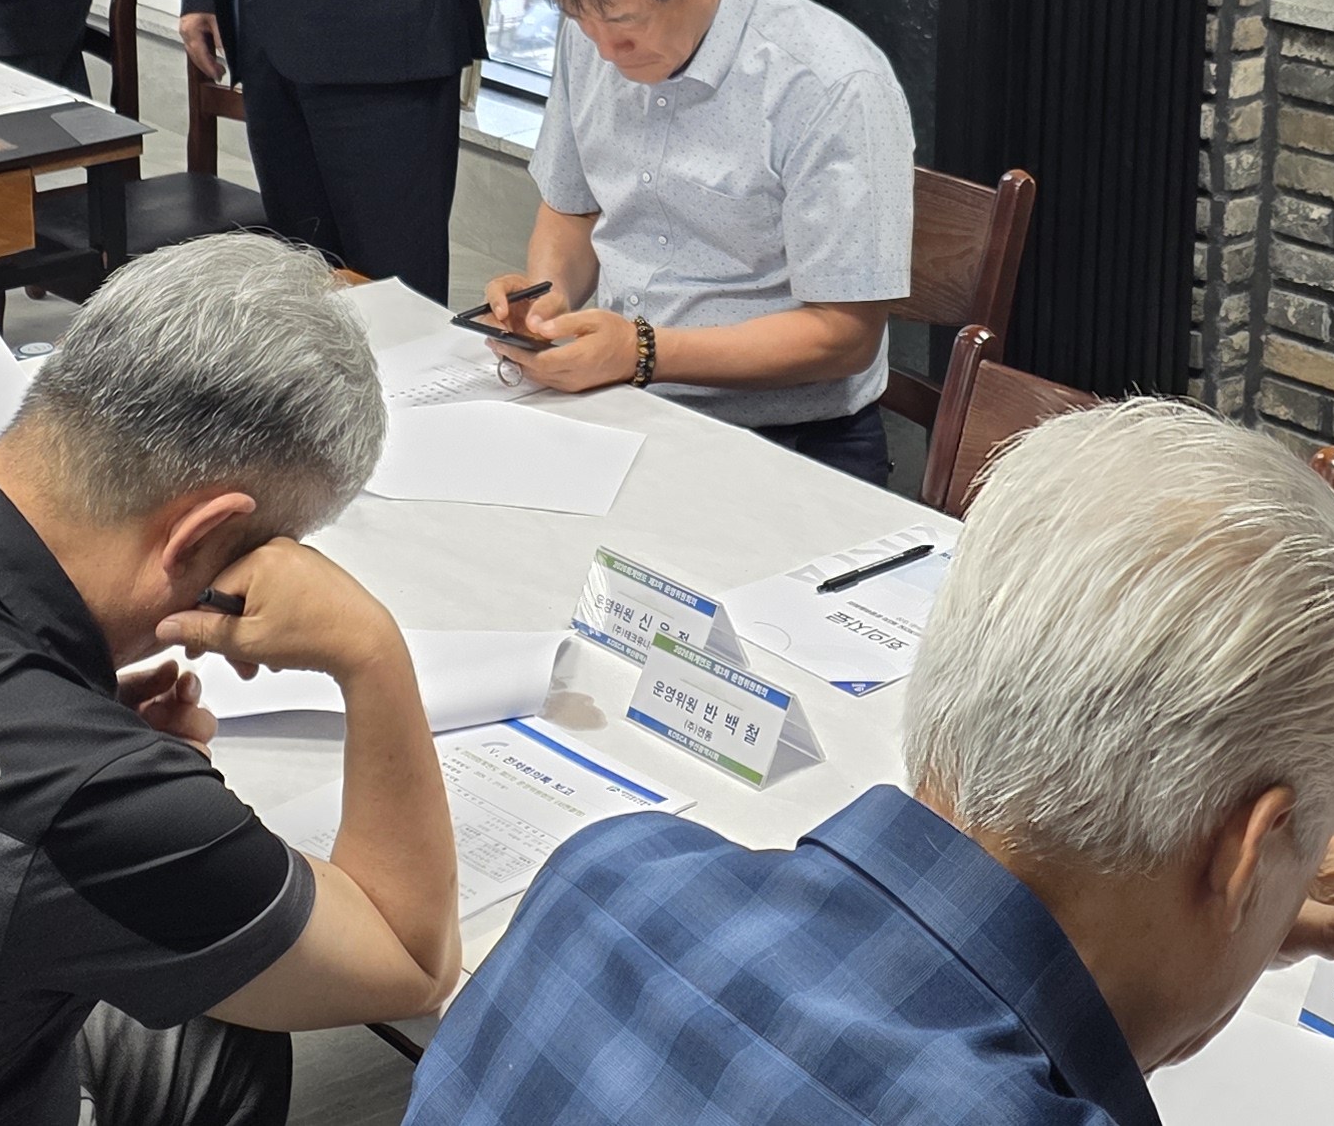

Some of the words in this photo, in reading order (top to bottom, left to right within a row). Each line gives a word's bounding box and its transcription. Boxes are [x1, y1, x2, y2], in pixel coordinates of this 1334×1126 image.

[612, 623, 652, 651] (주)테크유니
[652, 679, 699, 715] 운영위원
[667, 728, 687, 745] KOSCA
